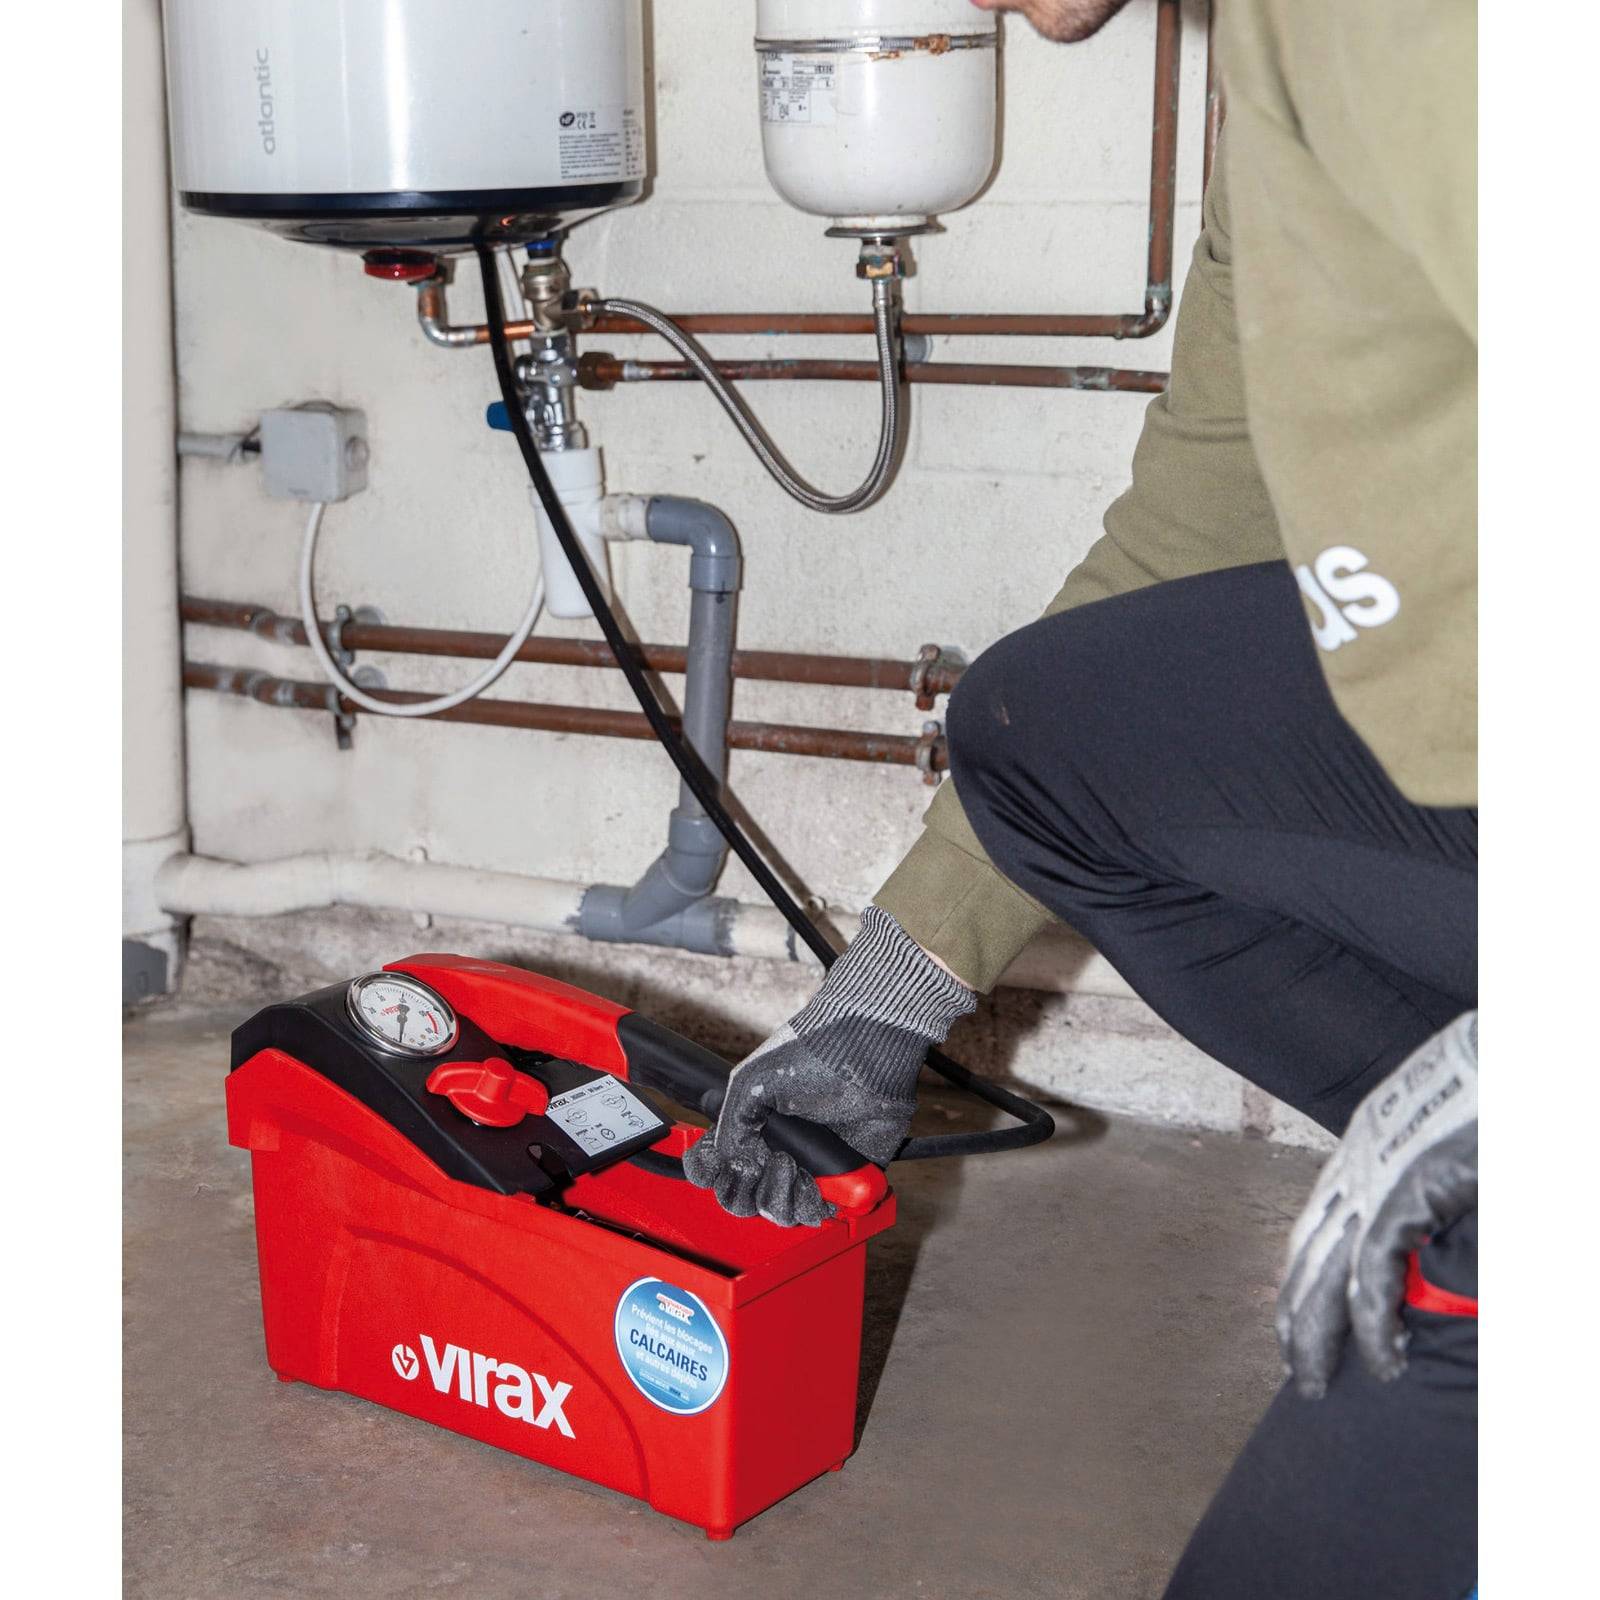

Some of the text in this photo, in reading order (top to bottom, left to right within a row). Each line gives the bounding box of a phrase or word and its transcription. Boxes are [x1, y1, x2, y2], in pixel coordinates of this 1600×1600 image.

[253, 47, 276, 155] atlantic
[630, 1328, 708, 1382] CALCAIRES
[631, 1303, 664, 1328] Prévient
[677, 1325, 713, 1355] blocages
[419, 1333, 576, 1440] virax
